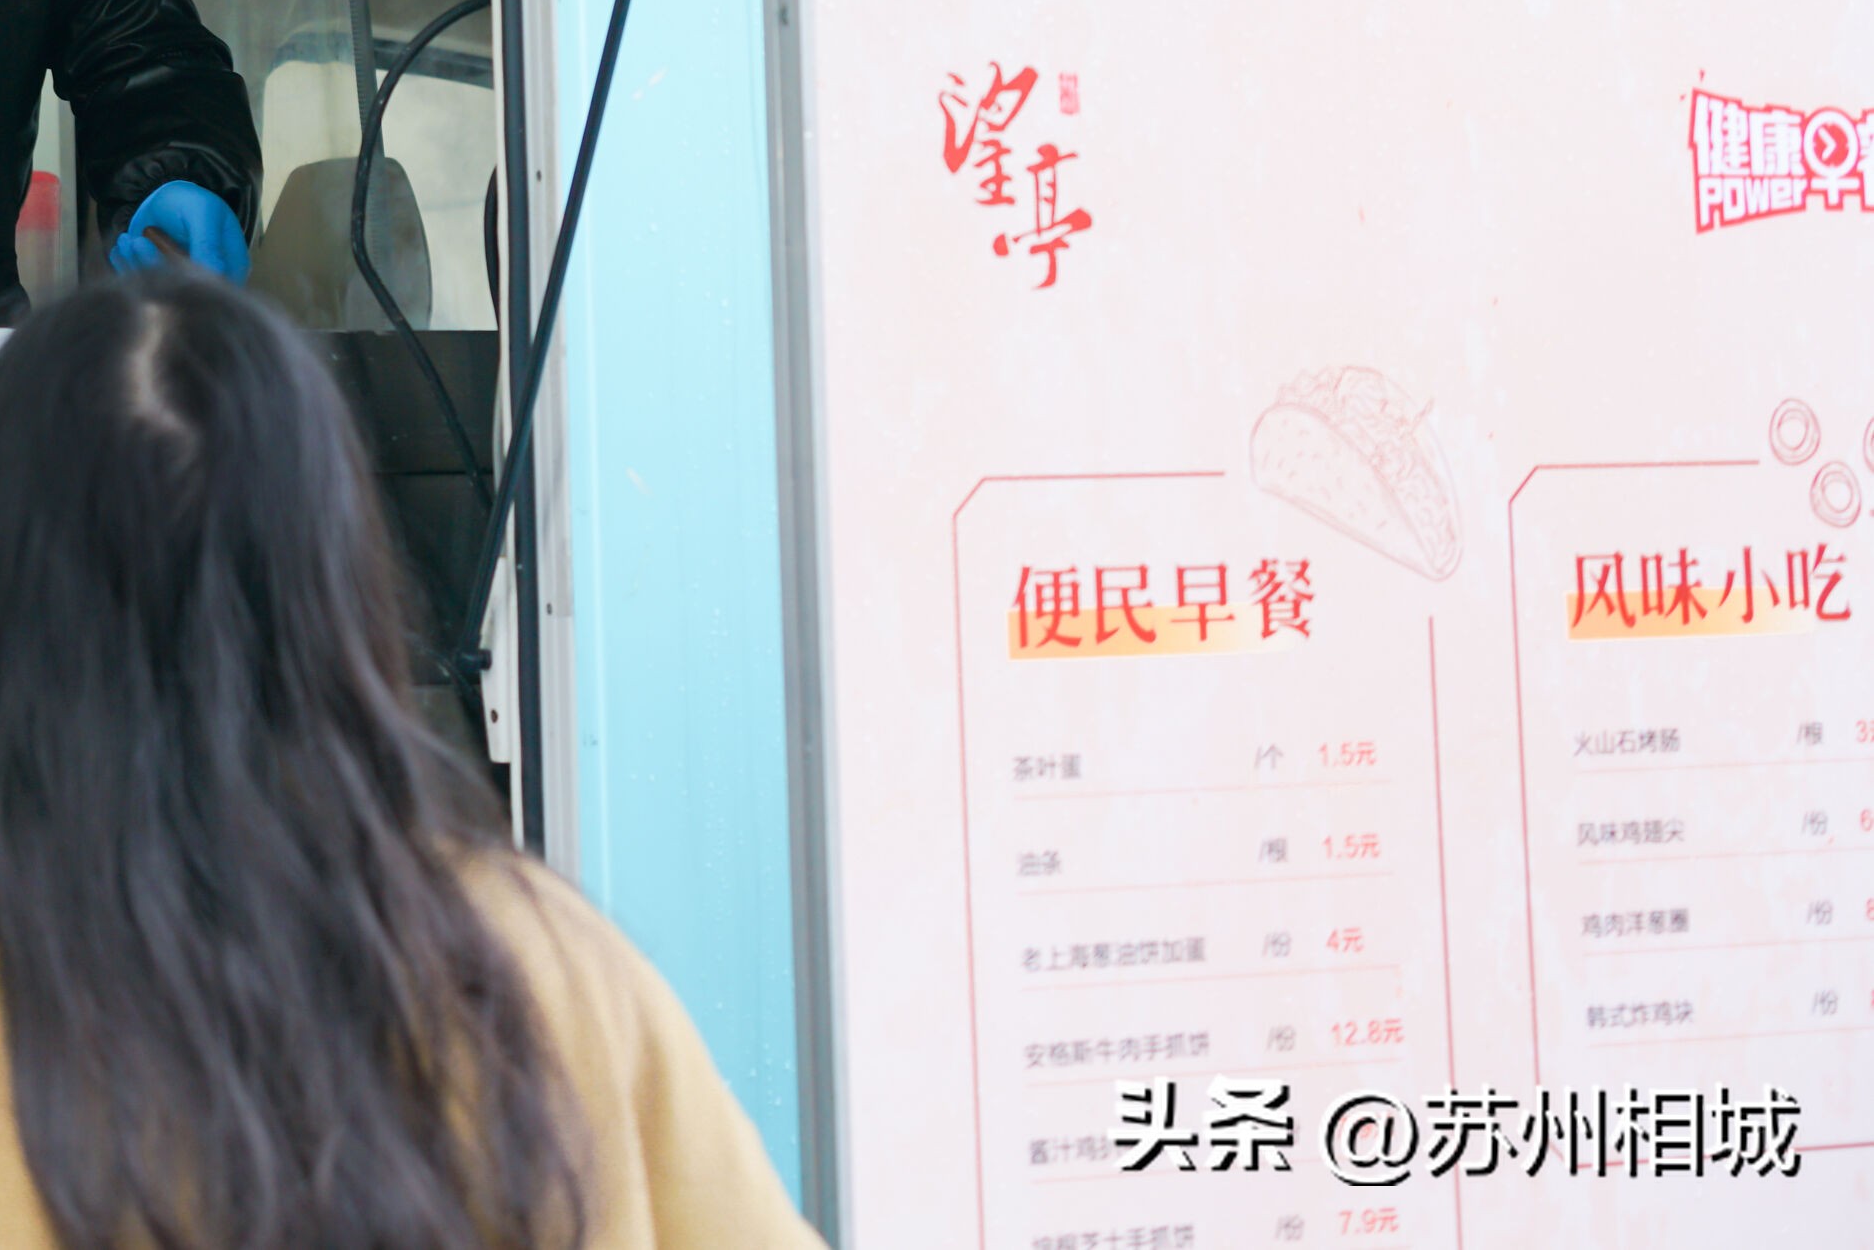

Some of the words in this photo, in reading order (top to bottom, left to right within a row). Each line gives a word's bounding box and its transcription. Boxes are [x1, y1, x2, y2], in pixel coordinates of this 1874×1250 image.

[1012, 558, 1315, 648] 便民早餐
[1571, 543, 1853, 629] 风味小吃
[1014, 754, 1081, 781] 茶叶蛋
[1319, 741, 1376, 766] 1.5元
[1574, 728, 1680, 756] 火山石烤肠
[1018, 850, 1062, 876] 油条
[1323, 833, 1380, 859] 1.5元
[1326, 927, 1364, 953] 4元
[1587, 1000, 1693, 1029] 韩式炸鸡块
[1025, 1031, 1210, 1069] 安格斯牛肉手抓饼
[1331, 1018, 1405, 1047] 12.8元
[1338, 1207, 1399, 1235] 7.9元
